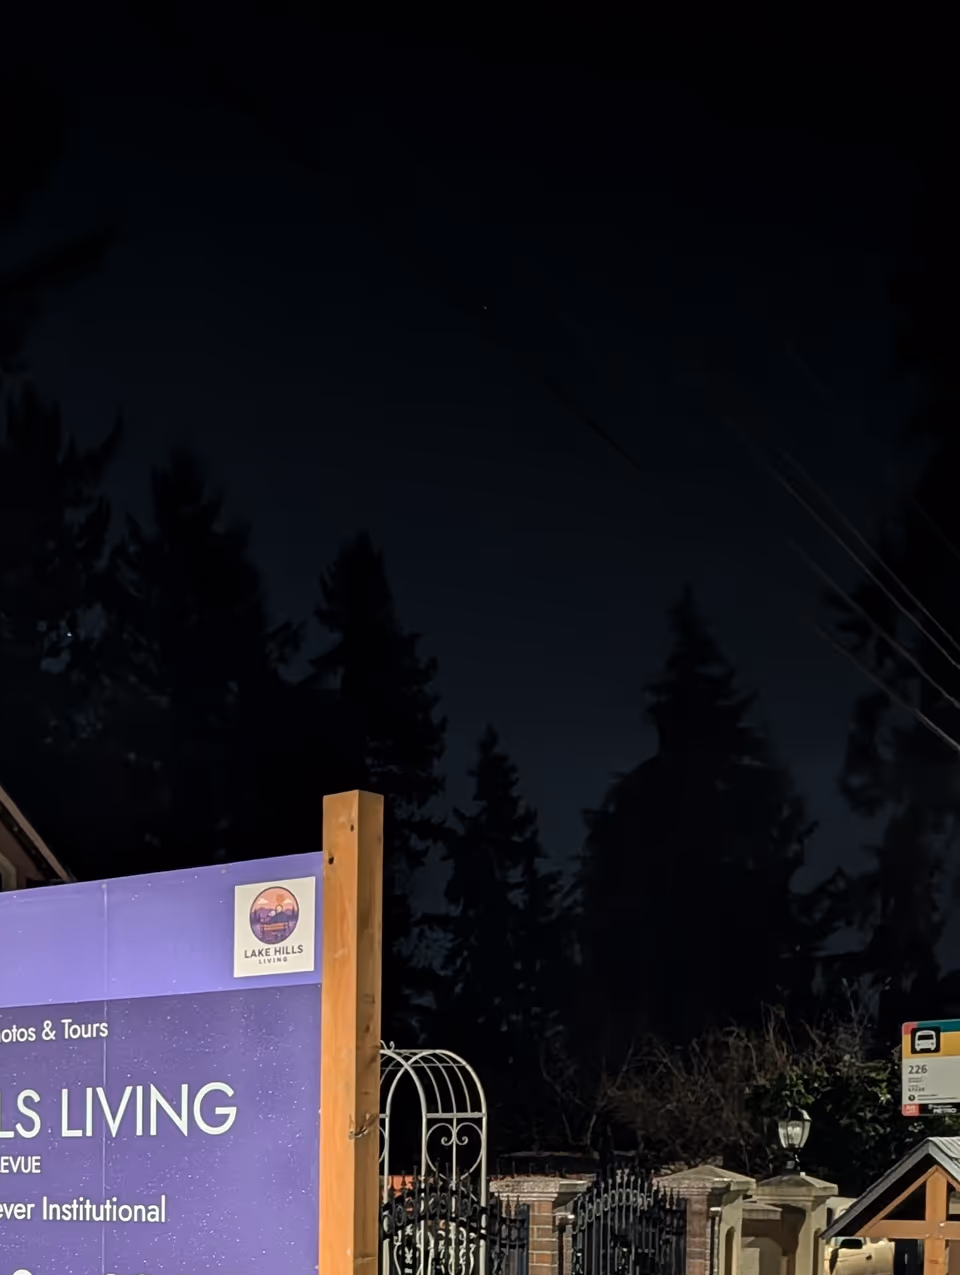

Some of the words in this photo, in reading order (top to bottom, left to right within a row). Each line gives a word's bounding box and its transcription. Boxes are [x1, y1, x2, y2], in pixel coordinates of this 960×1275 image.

[244, 948, 271, 958] LAKE
[274, 944, 304, 955] HILLS
[258, 956, 288, 964] LIVING
[42, 1019, 56, 1041] &
[61, 1018, 109, 1039] Tours
[908, 1064, 928, 1074] 226
[61, 1081, 238, 1138] LIVING
[42, 1194, 166, 1223] Institutional
